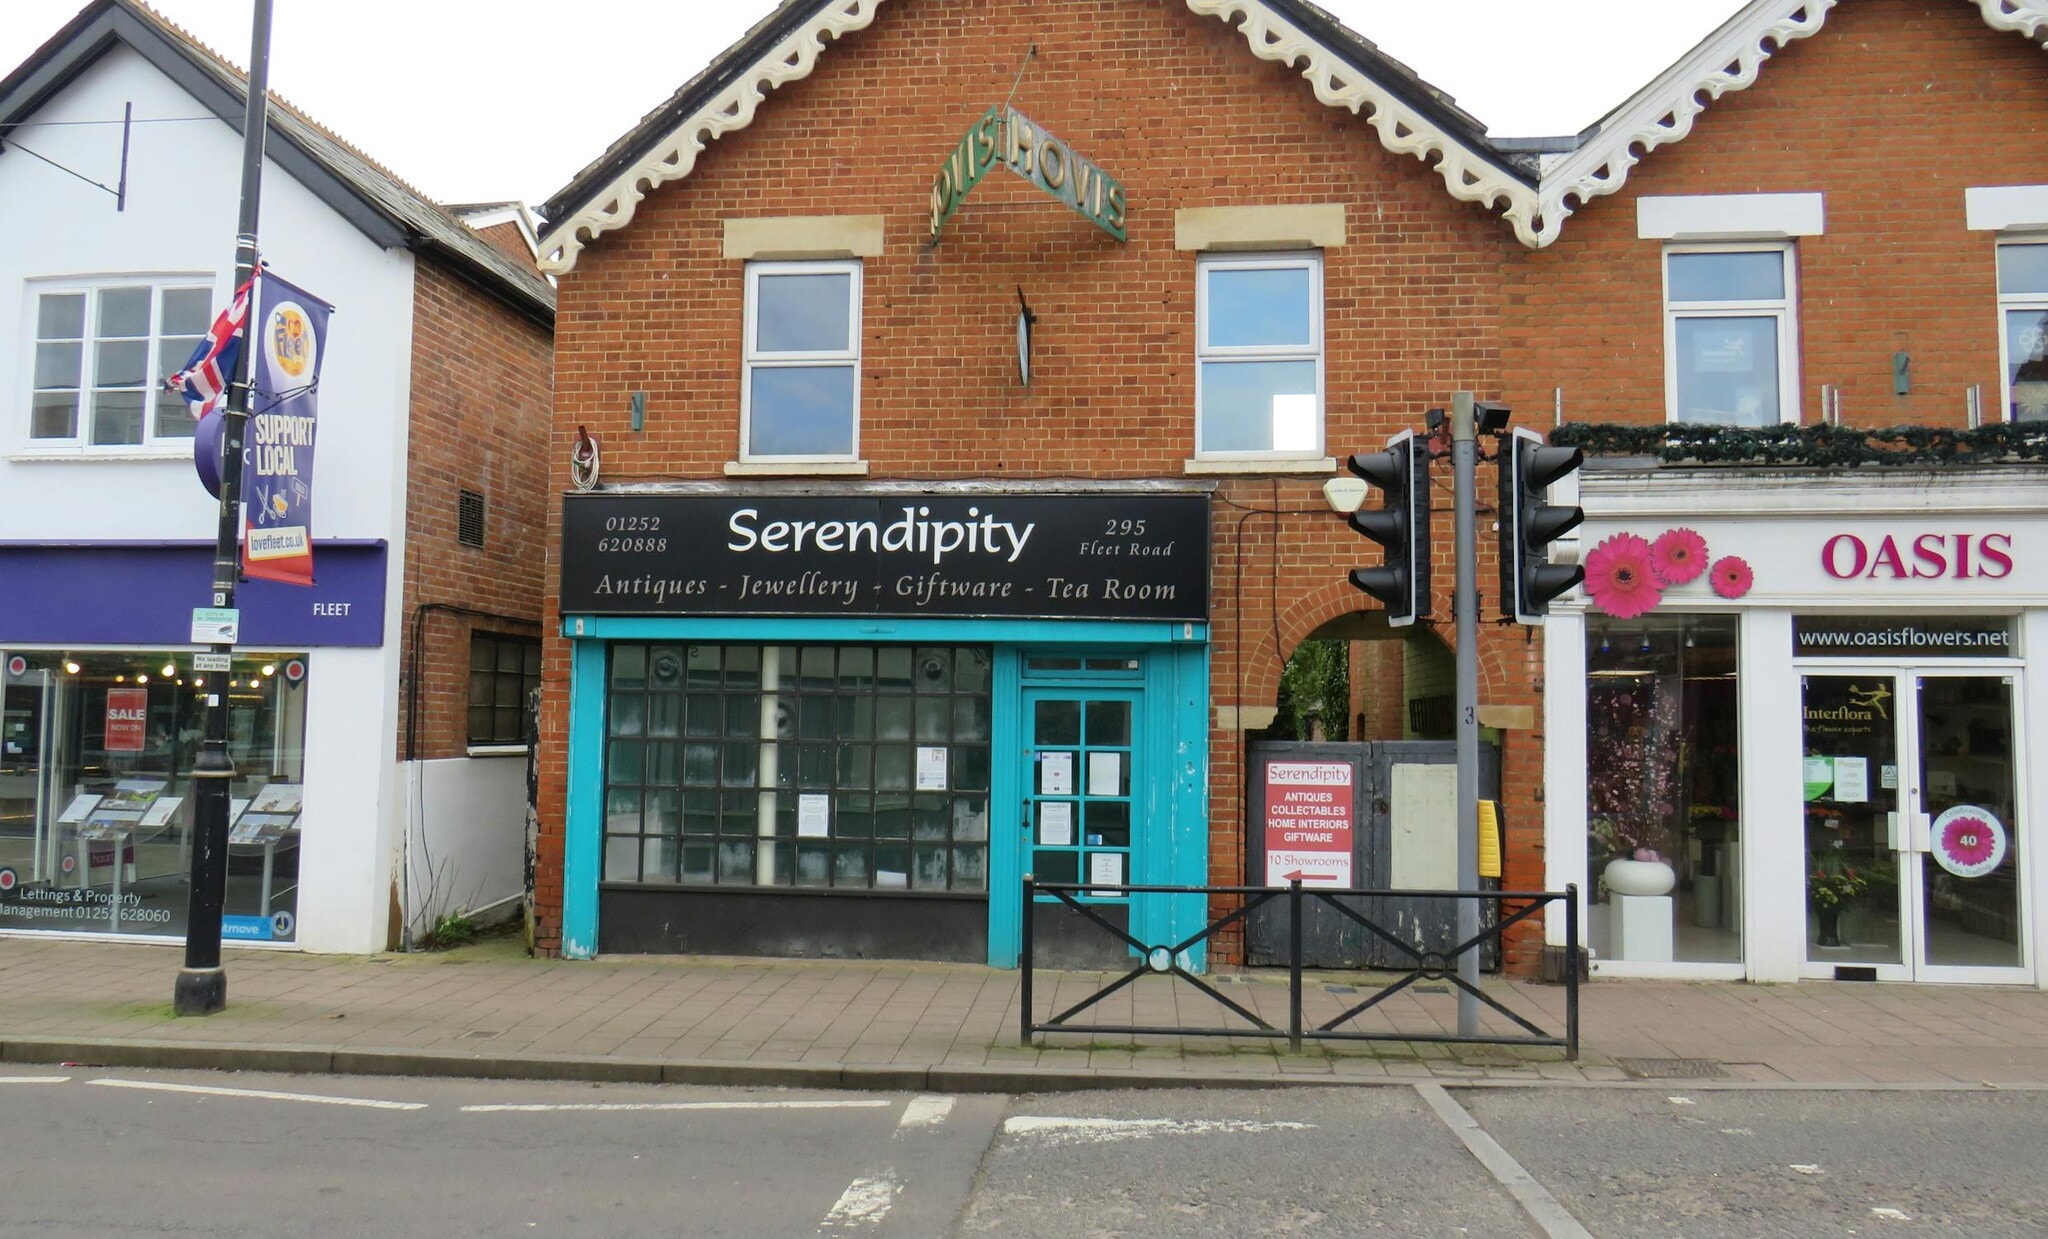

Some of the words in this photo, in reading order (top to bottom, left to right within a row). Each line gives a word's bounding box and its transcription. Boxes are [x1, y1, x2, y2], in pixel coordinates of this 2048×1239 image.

[1010, 115, 1125, 230] HOVIS
[255, 414, 315, 446] SUPPORT
[256, 445, 298, 476] LOCAL
[605, 516, 661, 531] 01252
[1105, 519, 1146, 536] 295
[251, 532, 305, 551] lovefleet.co.uk
[727, 506, 1035, 565] Serendipity
[598, 538, 667, 552] 620888
[1080, 541, 1121, 556] Fleet
[1129, 541, 1175, 556] Road
[1821, 533, 2014, 579] OASIS
[594, 574, 708, 604] Antiques
[739, 570, 859, 605] Jewellery
[895, 572, 1012, 606] Giftware
[1046, 578, 1089, 600] Tea
[1102, 578, 1176, 601] Room
[313, 603, 351, 616] FLEET
[1799, 627, 2009, 646] www.oasisflowers.net
[108, 709, 145, 720] SALE
[1465, 706, 1474, 725] 3
[1803, 706, 1872, 720] Interflora
[1269, 766, 1349, 784] Serendipity
[1284, 792, 1333, 803] ANTIQUES
[1271, 805, 1346, 816] COLLECTABLES
[1268, 819, 1296, 829] HOME
[1298, 819, 1349, 830] INTERIORS
[1283, 832, 1333, 843] GIFTWARE
[1959, 835, 1978, 847] 40
[1269, 855, 1282, 866] 10
[1284, 855, 1349, 867] Showrooms
[20, 887, 71, 904] Lettings
[73, 889, 83, 902] &
[86, 890, 142, 907] Property
[0, 902, 74, 919] anagement
[76, 906, 118, 920] 01252
[120, 908, 171, 922] 628060
[222, 923, 260, 935] tmove
